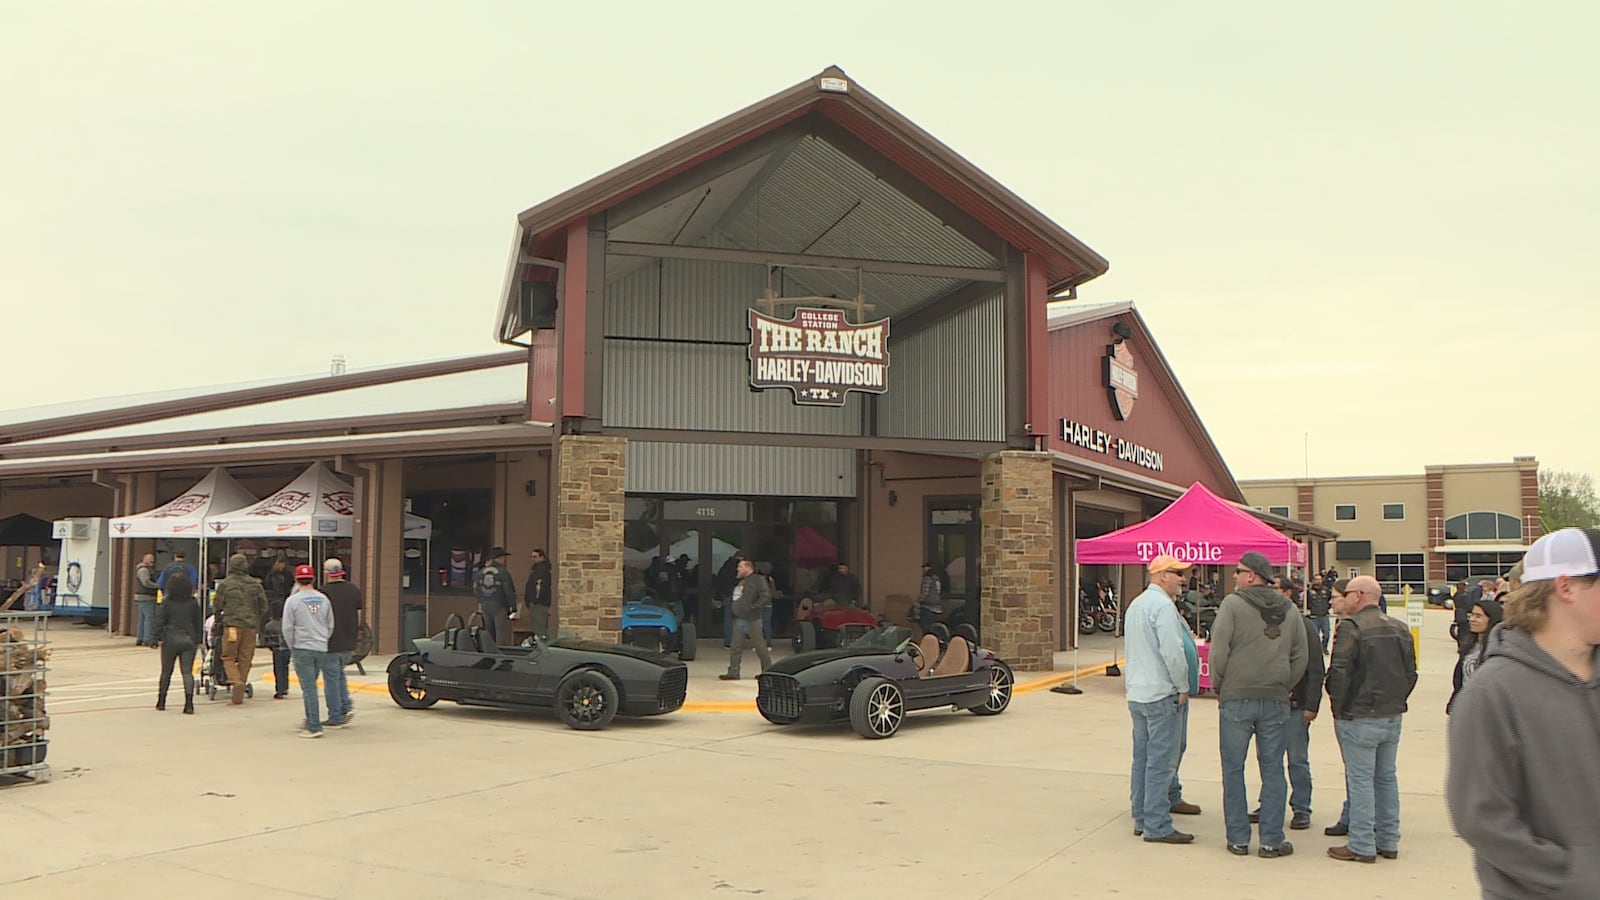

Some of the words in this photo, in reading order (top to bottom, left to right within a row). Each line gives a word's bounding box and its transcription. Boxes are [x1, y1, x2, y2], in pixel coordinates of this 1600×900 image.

[801, 312, 839, 322] COLLEGE
[801, 320, 838, 329] STATION
[756, 318, 802, 353] THE
[805, 325, 883, 360] RANCH
[757, 357, 883, 386] HARLEY-DAVIDSON
[810, 388, 830, 400] TX
[1061, 418, 1164, 472] HARLEY-DAVIDSON
[696, 507, 716, 517] 4115
